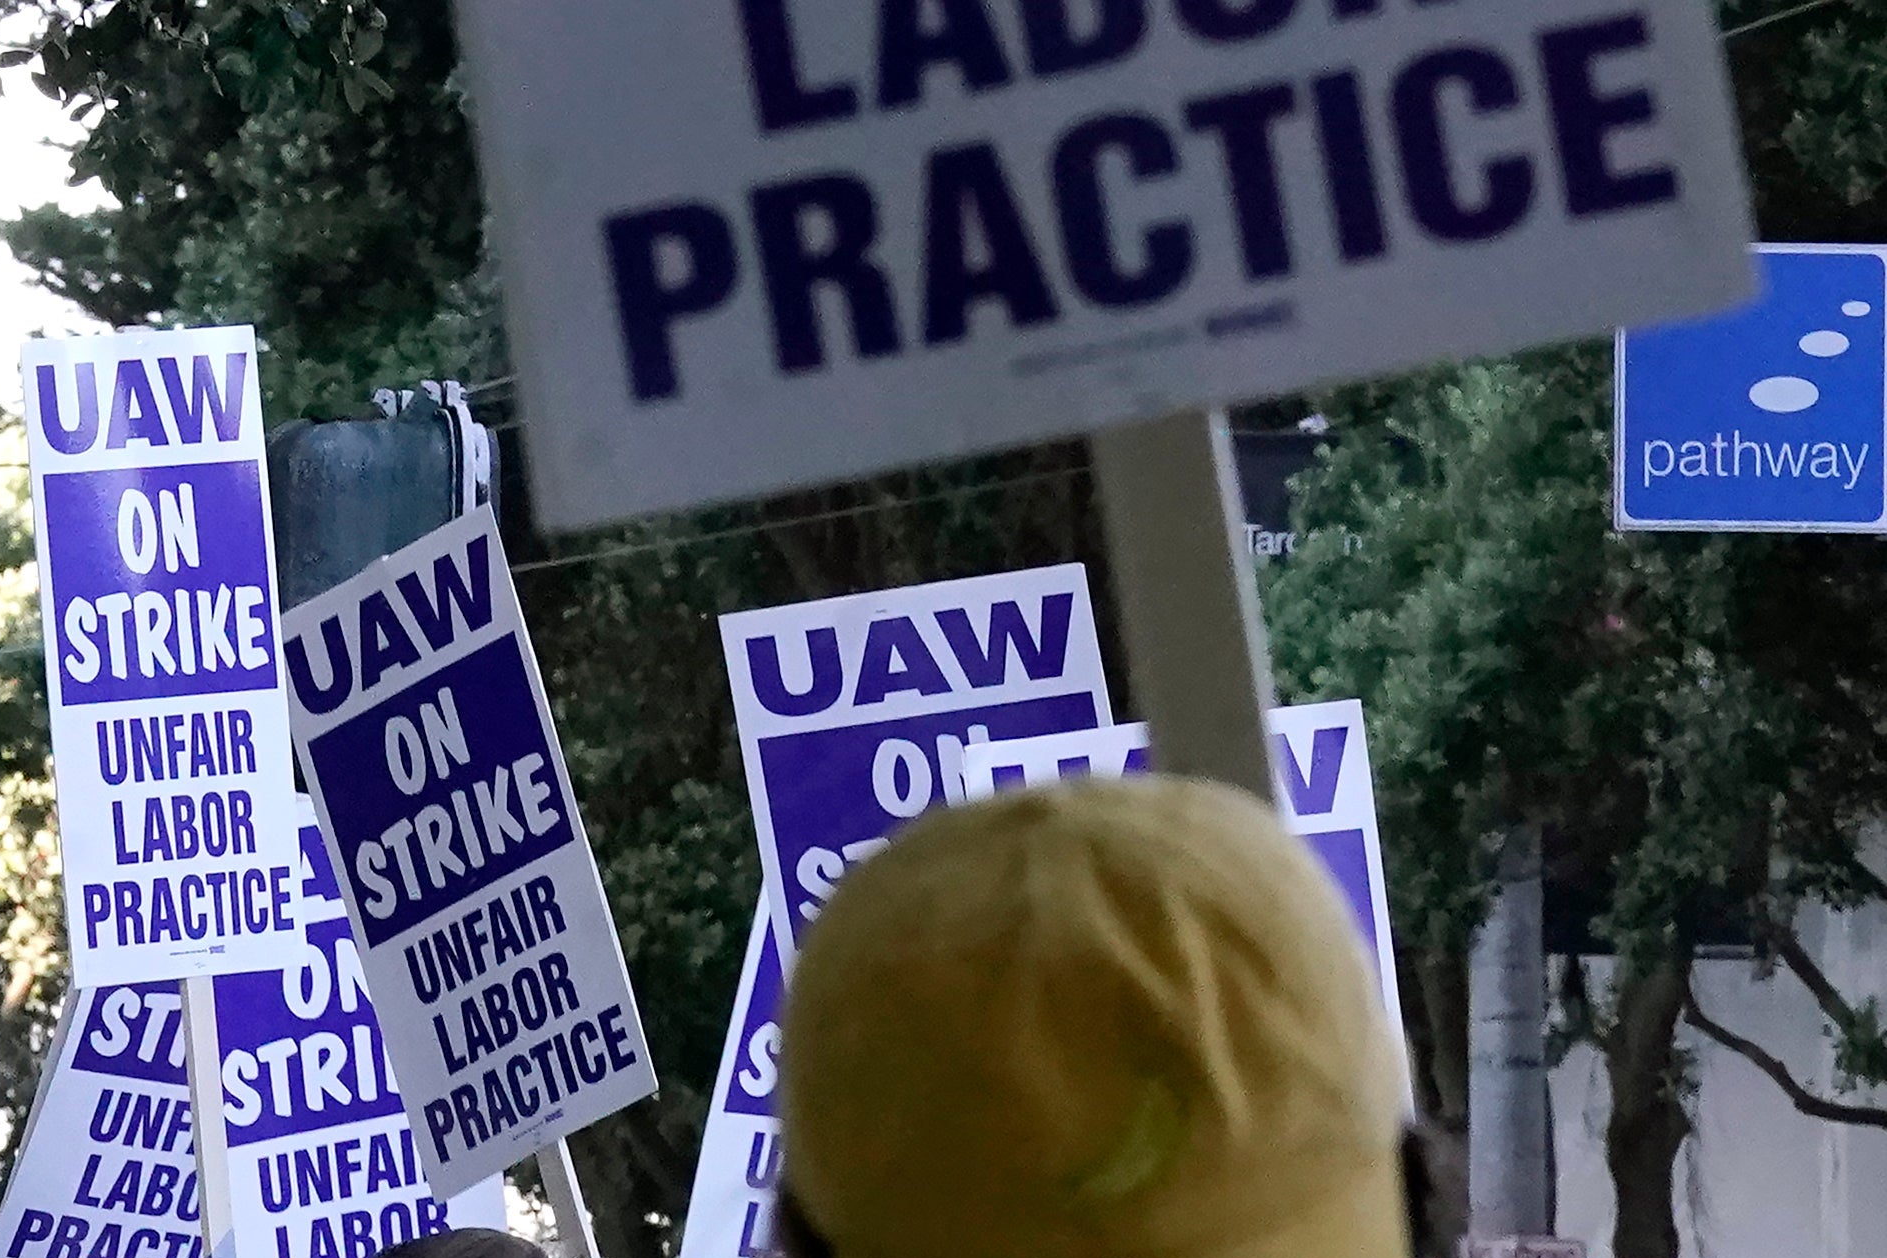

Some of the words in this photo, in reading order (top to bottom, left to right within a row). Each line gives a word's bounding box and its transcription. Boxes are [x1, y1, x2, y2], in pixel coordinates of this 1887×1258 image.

[597, 8, 1685, 404] PRACTICE
[36, 352, 247, 456] UAW
[1643, 429, 1869, 490] pathway
[117, 482, 201, 574] ON
[63, 581, 271, 686] STRIKE
[283, 534, 494, 716] UAW
[745, 592, 1074, 717] UAW
[96, 708, 256, 785] UNFAIR
[384, 686, 470, 796] ON
[112, 789, 256, 866] LABOR
[355, 752, 560, 921] STRIKE
[82, 865, 295, 949] PRACTICE
[403, 875, 567, 1005] UNFAIR
[433, 952, 581, 1076] LABOR
[221, 1023, 401, 1128] STRI
[424, 1003, 638, 1164] PRACTICE
[73, 1153, 201, 1223] LABO
[257, 1128, 428, 1214] UNFAI
